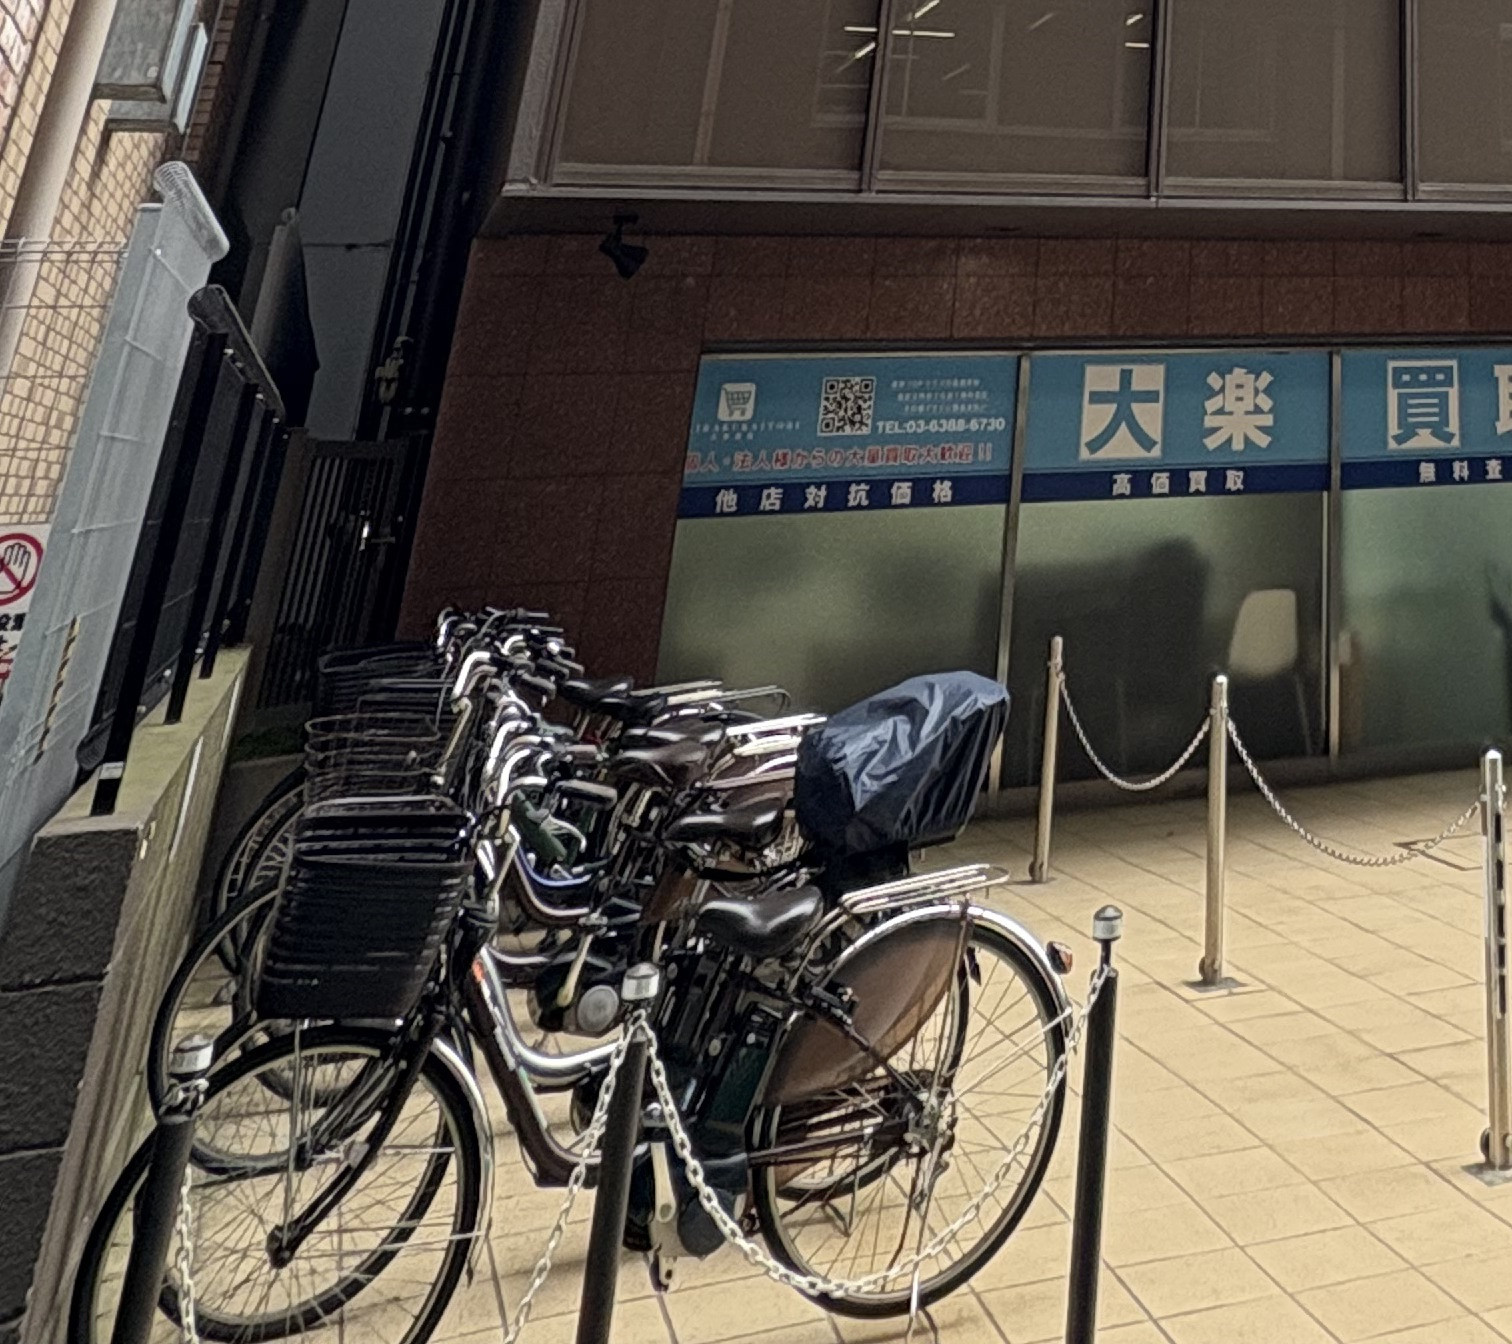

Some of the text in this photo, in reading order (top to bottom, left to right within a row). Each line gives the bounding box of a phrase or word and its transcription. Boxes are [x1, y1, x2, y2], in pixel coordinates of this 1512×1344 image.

[1082, 365, 1275, 455] 大楽
[715, 479, 953, 513] 他店対抗価格
[1111, 470, 1245, 497] 高価買取
